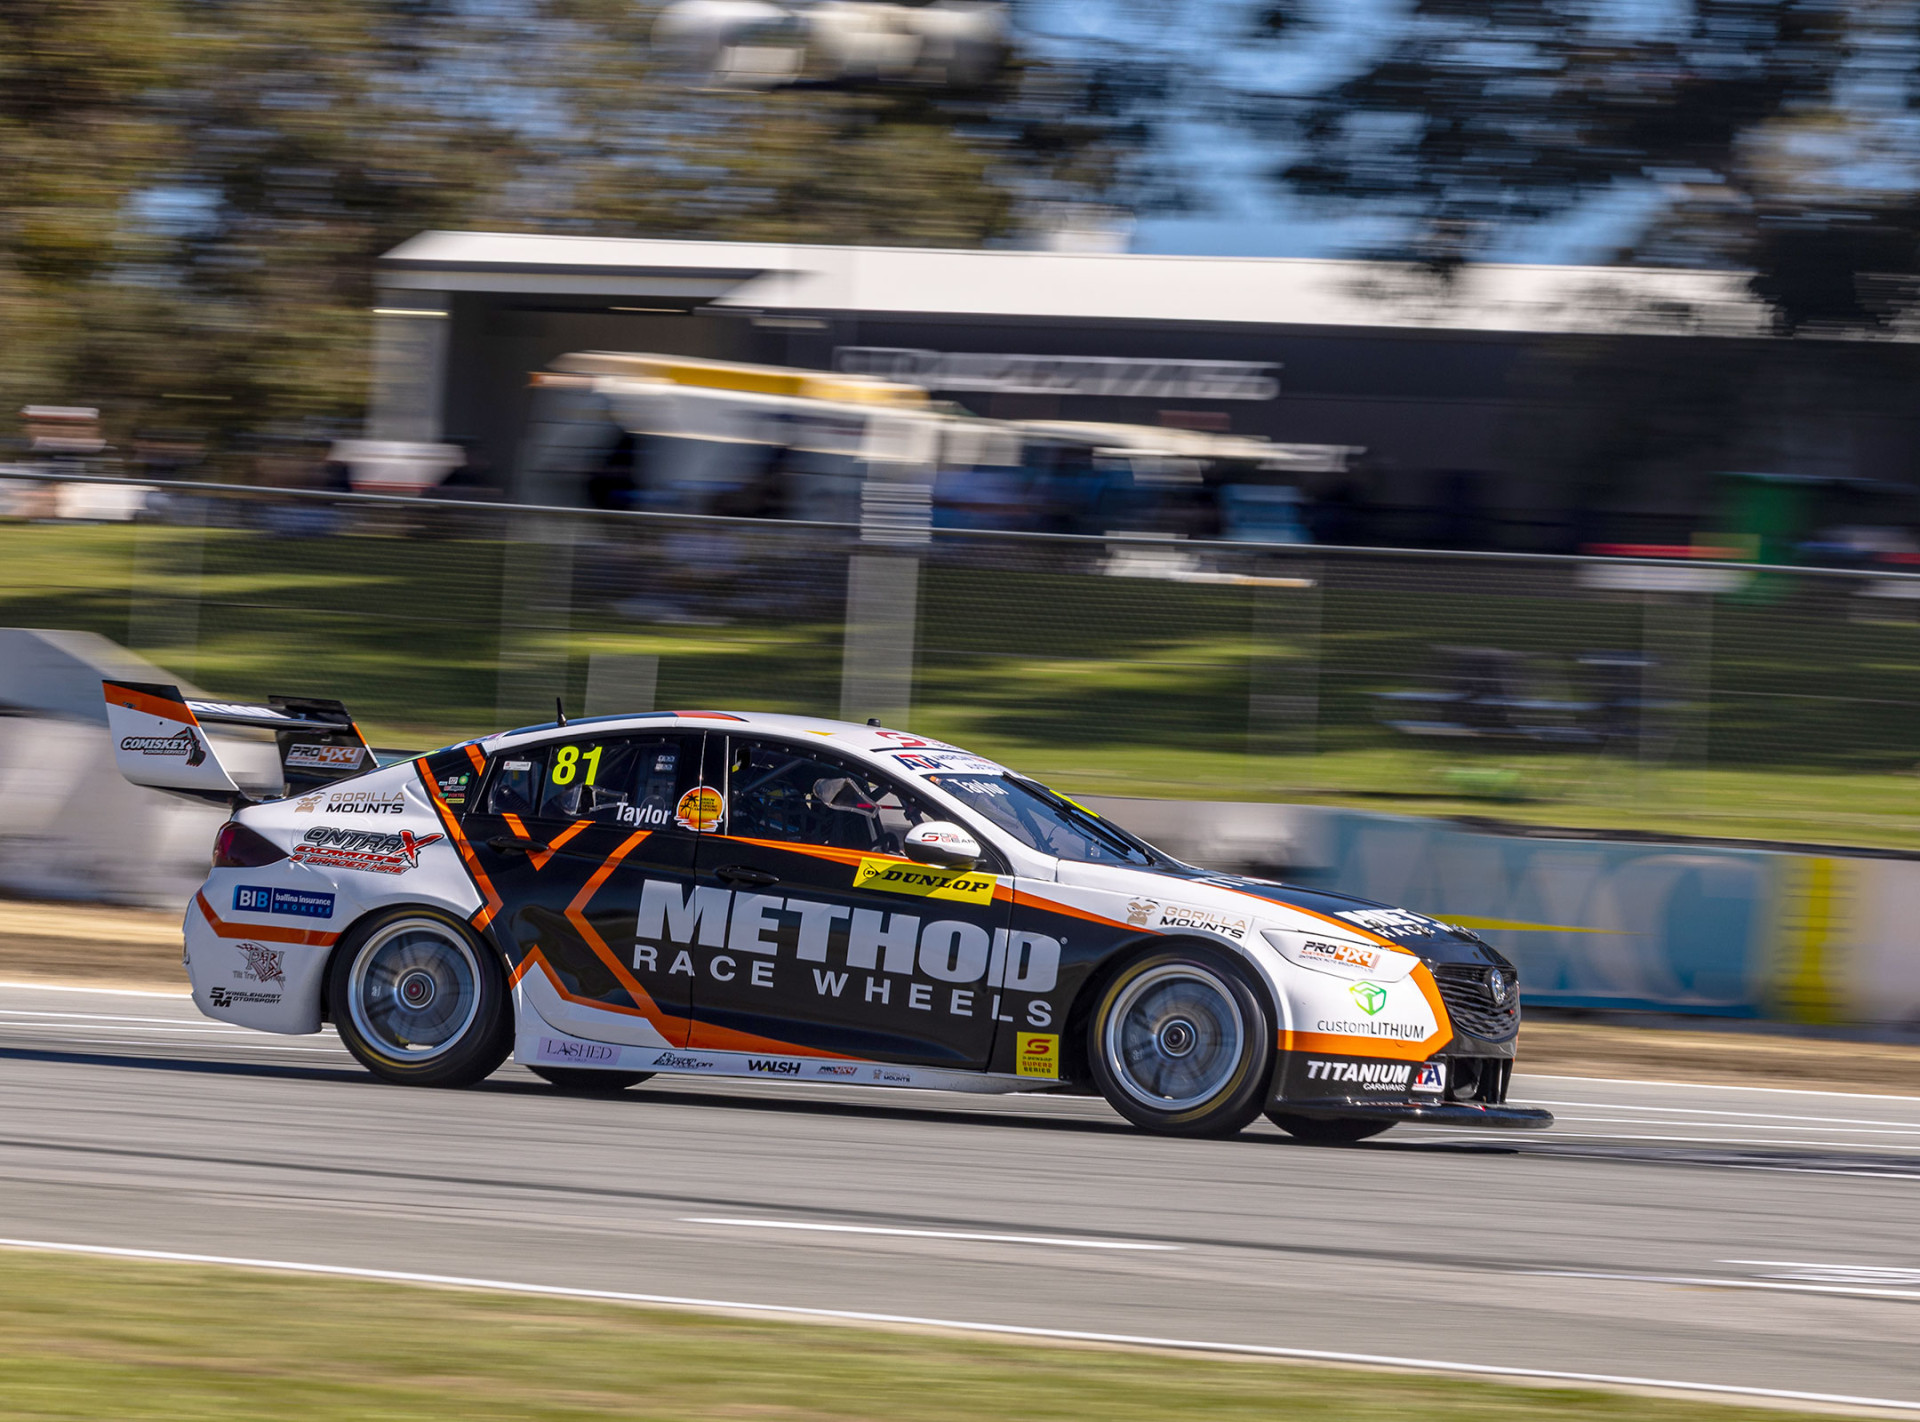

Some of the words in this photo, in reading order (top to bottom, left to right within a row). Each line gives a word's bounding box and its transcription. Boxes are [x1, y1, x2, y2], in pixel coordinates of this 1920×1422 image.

[121, 738, 191, 750] COMISKEY
[552, 745, 603, 786] 81
[329, 792, 406, 802] GORILLA
[325, 803, 405, 814] MOUNTS
[616, 801, 671, 826] Taylor
[294, 845, 405, 864] EXCAVATIONS
[304, 826, 444, 868] ONTRAX
[305, 854, 367, 872] GRADER
[369, 862, 410, 875] HIRE
[881, 870, 990, 892] DUNLOP
[239, 889, 268, 908] BIB
[274, 902, 330, 914] BROKERS
[275, 893, 298, 903] ballina
[298, 895, 332, 906] insurance
[1160, 916, 1245, 939] MOUNTS
[1165, 906, 1247, 930] GORILLA
[635, 879, 1062, 994] METHOD
[243, 971, 257, 981] Tray
[633, 944, 775, 988] RACE
[812, 969, 1053, 1027] WHEELS
[209, 987, 282, 999] SWINGLEHURST
[213, 996, 282, 1008] MOTORSPORT
[1316, 1020, 1425, 1039] customLITHIUM
[546, 1040, 612, 1060] LASHED
[748, 1059, 801, 1074] WALSH
[1307, 1060, 1412, 1083] TITANIUM
[1362, 1082, 1407, 1092] CARAVANS
